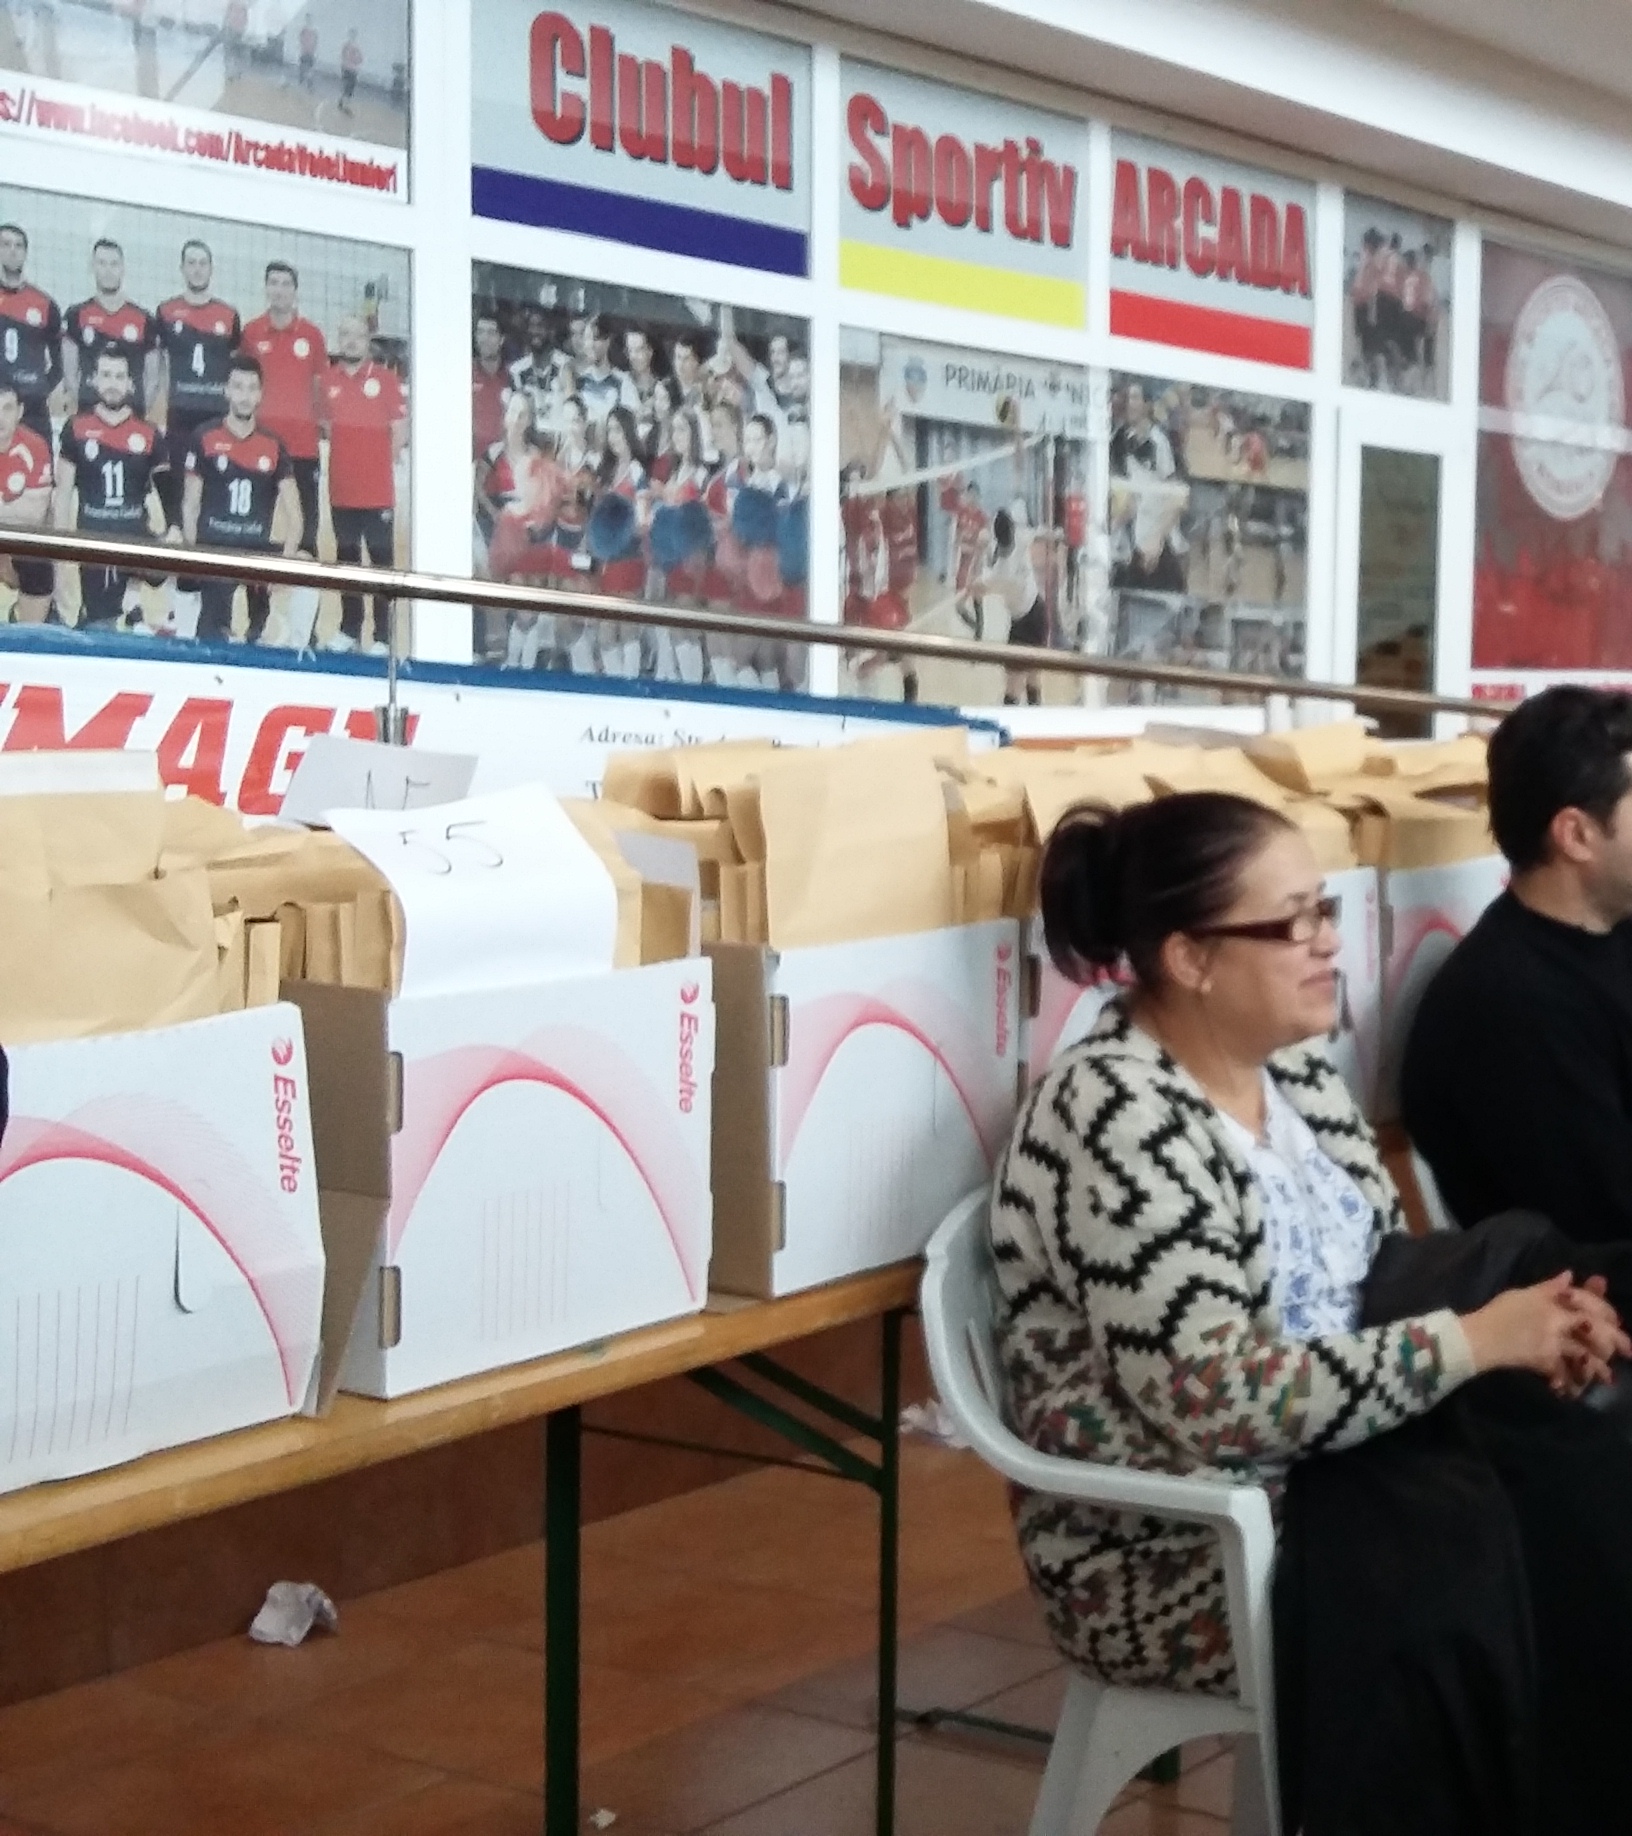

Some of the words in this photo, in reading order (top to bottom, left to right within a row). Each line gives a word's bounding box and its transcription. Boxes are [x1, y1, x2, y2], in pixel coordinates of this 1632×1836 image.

[529, 11, 794, 191] Clubul
[846, 93, 1077, 249] Sportiv
[1110, 159, 1312, 300] ARCADA
[102, 460, 125, 497] 11
[581, 725, 664, 746] Adresa:
[679, 1010, 699, 1114] Esselte
[274, 1073, 302, 1194] Esselte
